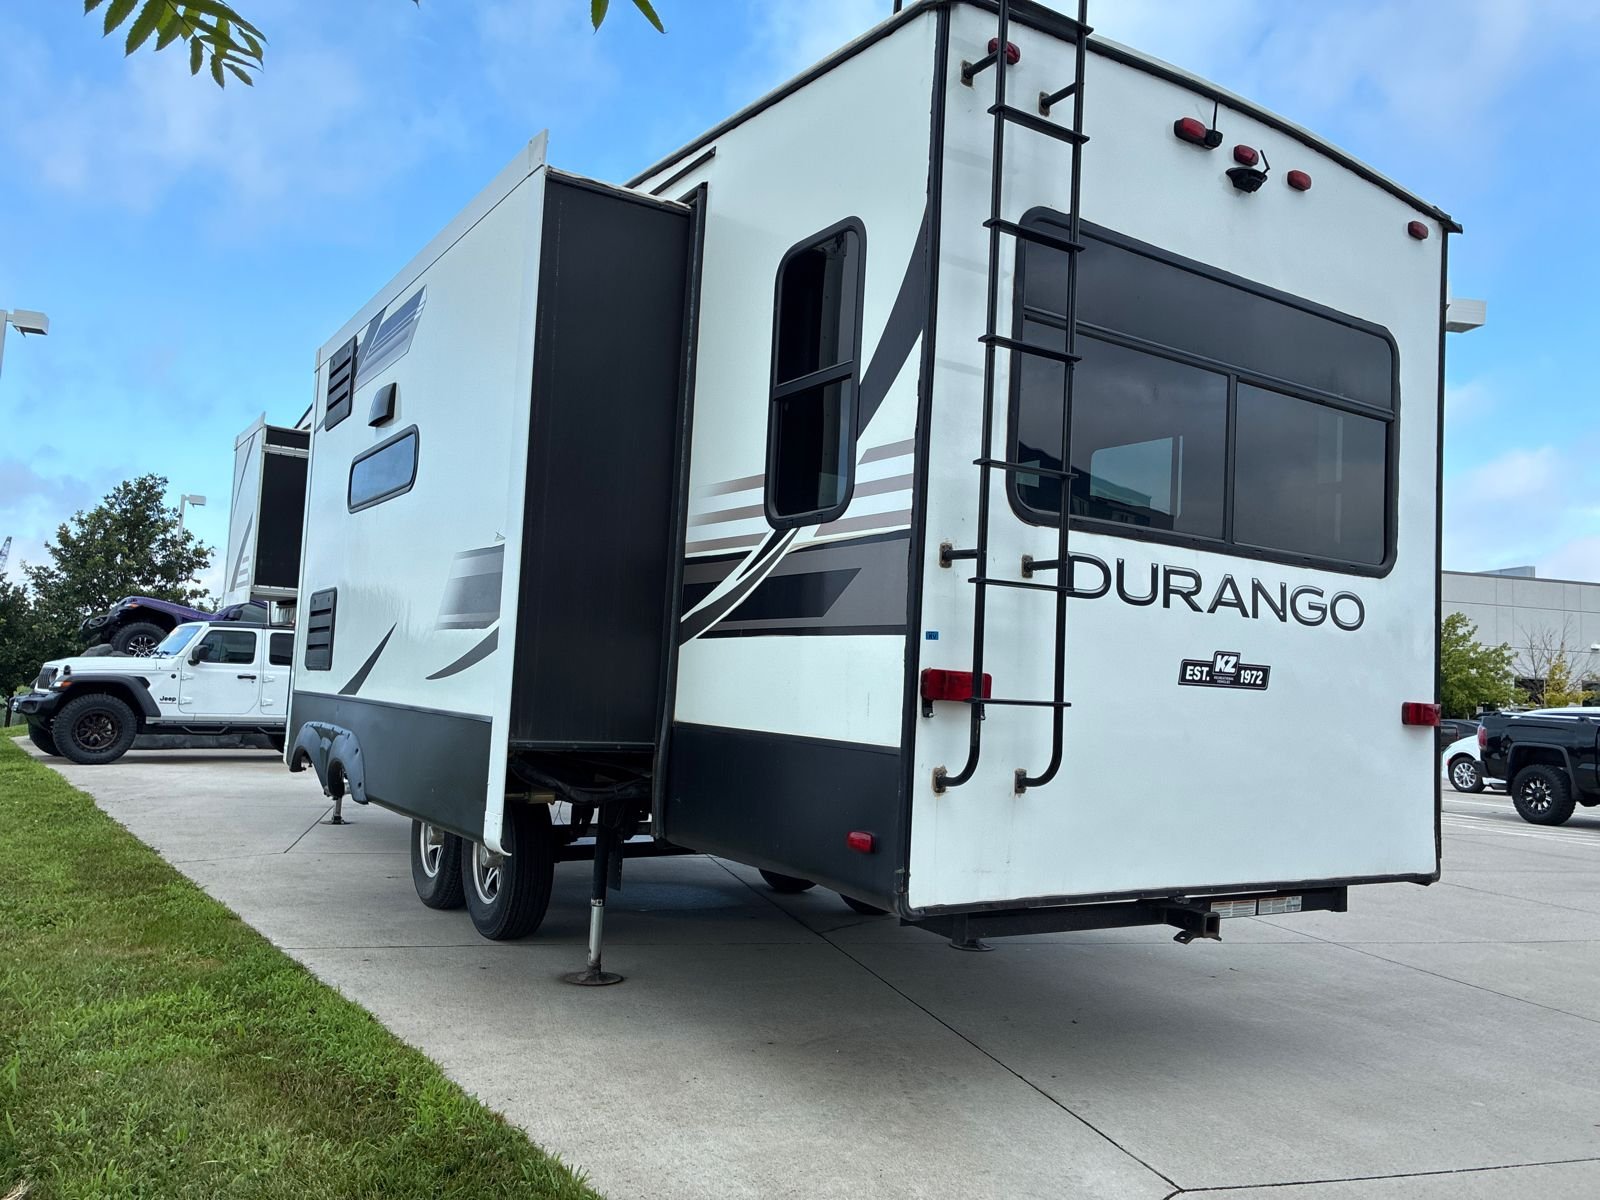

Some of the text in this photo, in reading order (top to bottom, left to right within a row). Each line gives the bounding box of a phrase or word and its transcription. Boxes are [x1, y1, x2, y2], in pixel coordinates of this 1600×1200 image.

[1066, 551, 1366, 632] DURANGO
[1215, 655, 1237, 673] KZ
[1186, 665, 1264, 685] EST. 1972
[160, 695, 176, 703] Jeep
